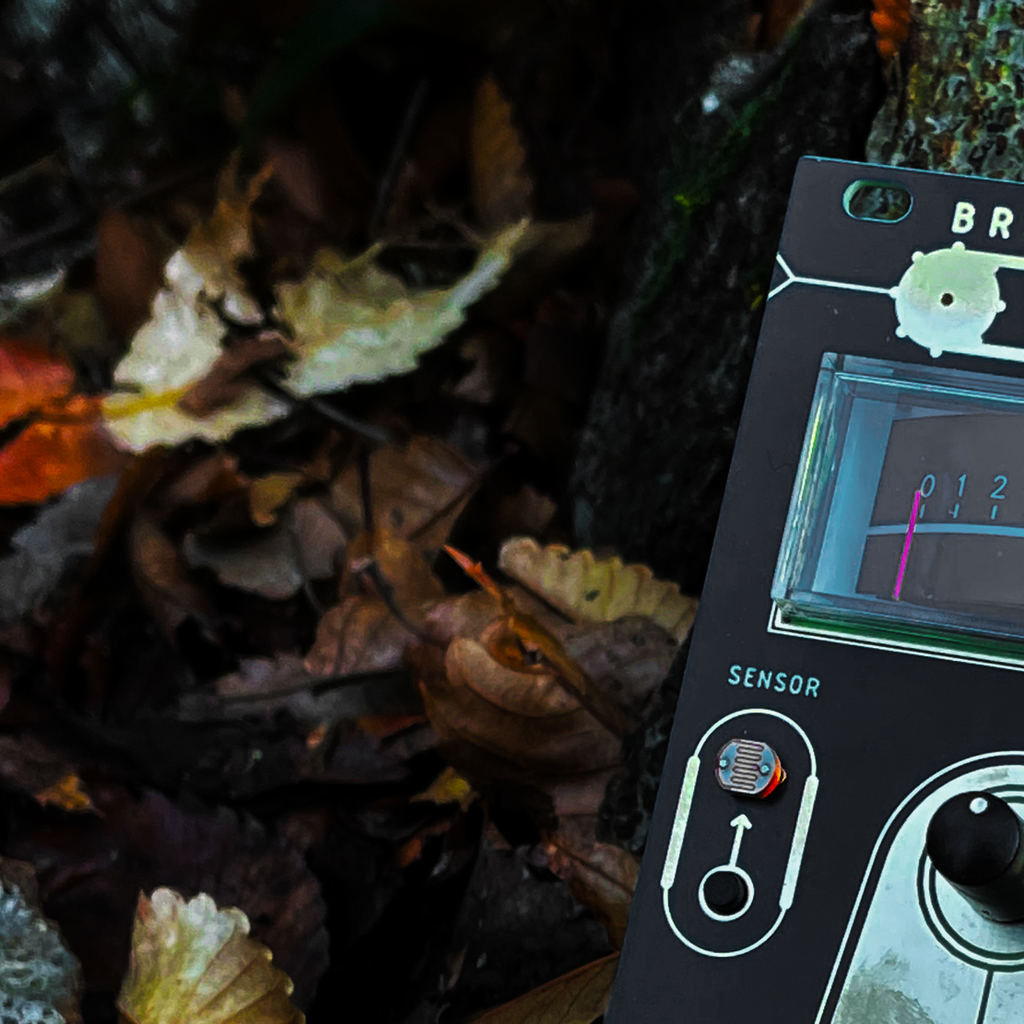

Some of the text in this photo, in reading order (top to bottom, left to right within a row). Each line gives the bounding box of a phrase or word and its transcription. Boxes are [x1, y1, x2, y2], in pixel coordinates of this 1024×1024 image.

[920, 474, 936, 499] 0
[958, 473, 967, 497] 1
[989, 474, 1008, 500] 2
[727, 664, 821, 698] SENSOR
